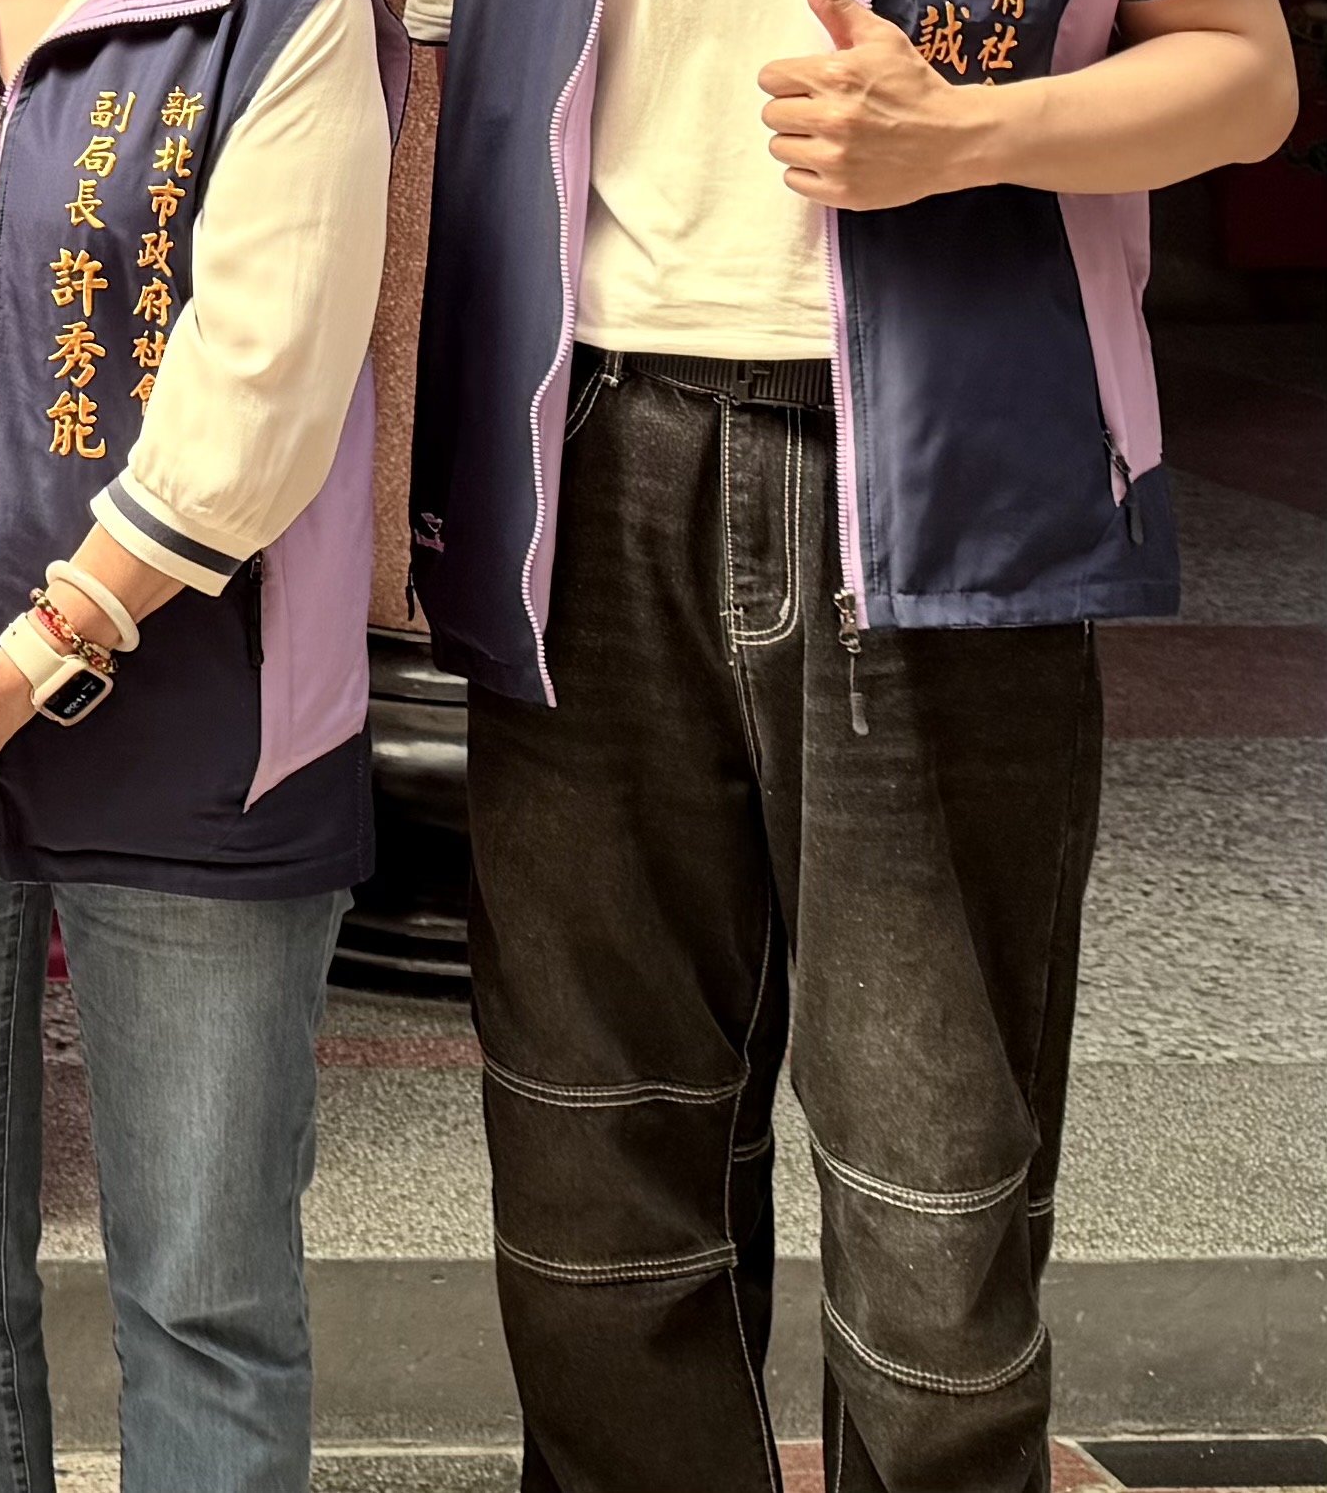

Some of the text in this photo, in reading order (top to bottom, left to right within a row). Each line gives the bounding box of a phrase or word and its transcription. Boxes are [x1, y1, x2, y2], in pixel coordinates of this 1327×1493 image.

[47, 91, 137, 461] 副局長 許秀能
